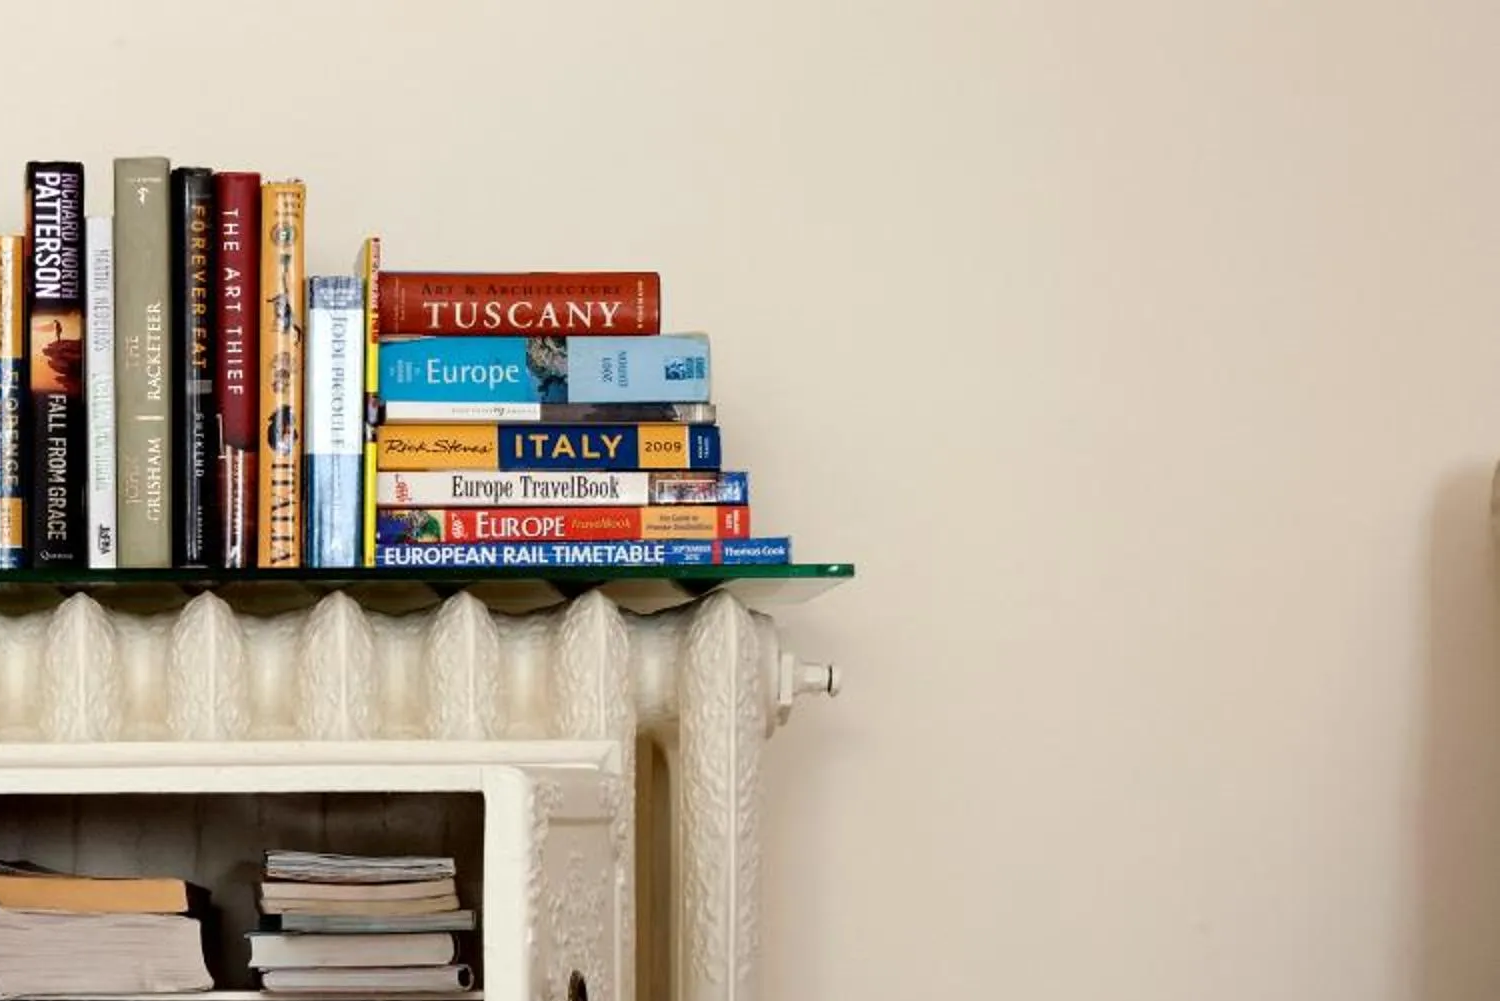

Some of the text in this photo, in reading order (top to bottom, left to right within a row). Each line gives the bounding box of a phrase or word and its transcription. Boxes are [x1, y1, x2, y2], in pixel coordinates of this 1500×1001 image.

[34, 171, 61, 299] PATTERSON
[60, 172, 79, 299] RICHARD NORTH
[191, 204, 208, 316] FOREVER
[221, 208, 245, 395] THE ART THIEF
[421, 282, 623, 296] ART & ARCHITECTURE
[422, 300, 623, 329] TUSCANY
[124, 334, 140, 369] THE
[146, 302, 165, 401] RACKETEER
[330, 313, 349, 361] JODI
[426, 358, 520, 390] Europe
[602, 356, 614, 383] 2001
[618, 350, 629, 387] EDITION
[3, 369, 19, 487] FLORENCE
[383, 438, 493, 455] Rick Steves'
[514, 434, 624, 459] ITALY
[644, 440, 683, 454] 2009
[46, 394, 68, 541] FALL FROM GRACE
[146, 436, 164, 522] GRISHAM
[451, 475, 619, 501] Europe TravelBook
[270, 463, 296, 564] ITALIA
[475, 514, 565, 538] EUROPE
[383, 544, 665, 566] EUROPEAN RAIL TIMETABLE
[725, 545, 786, 557] Thomas Cook
